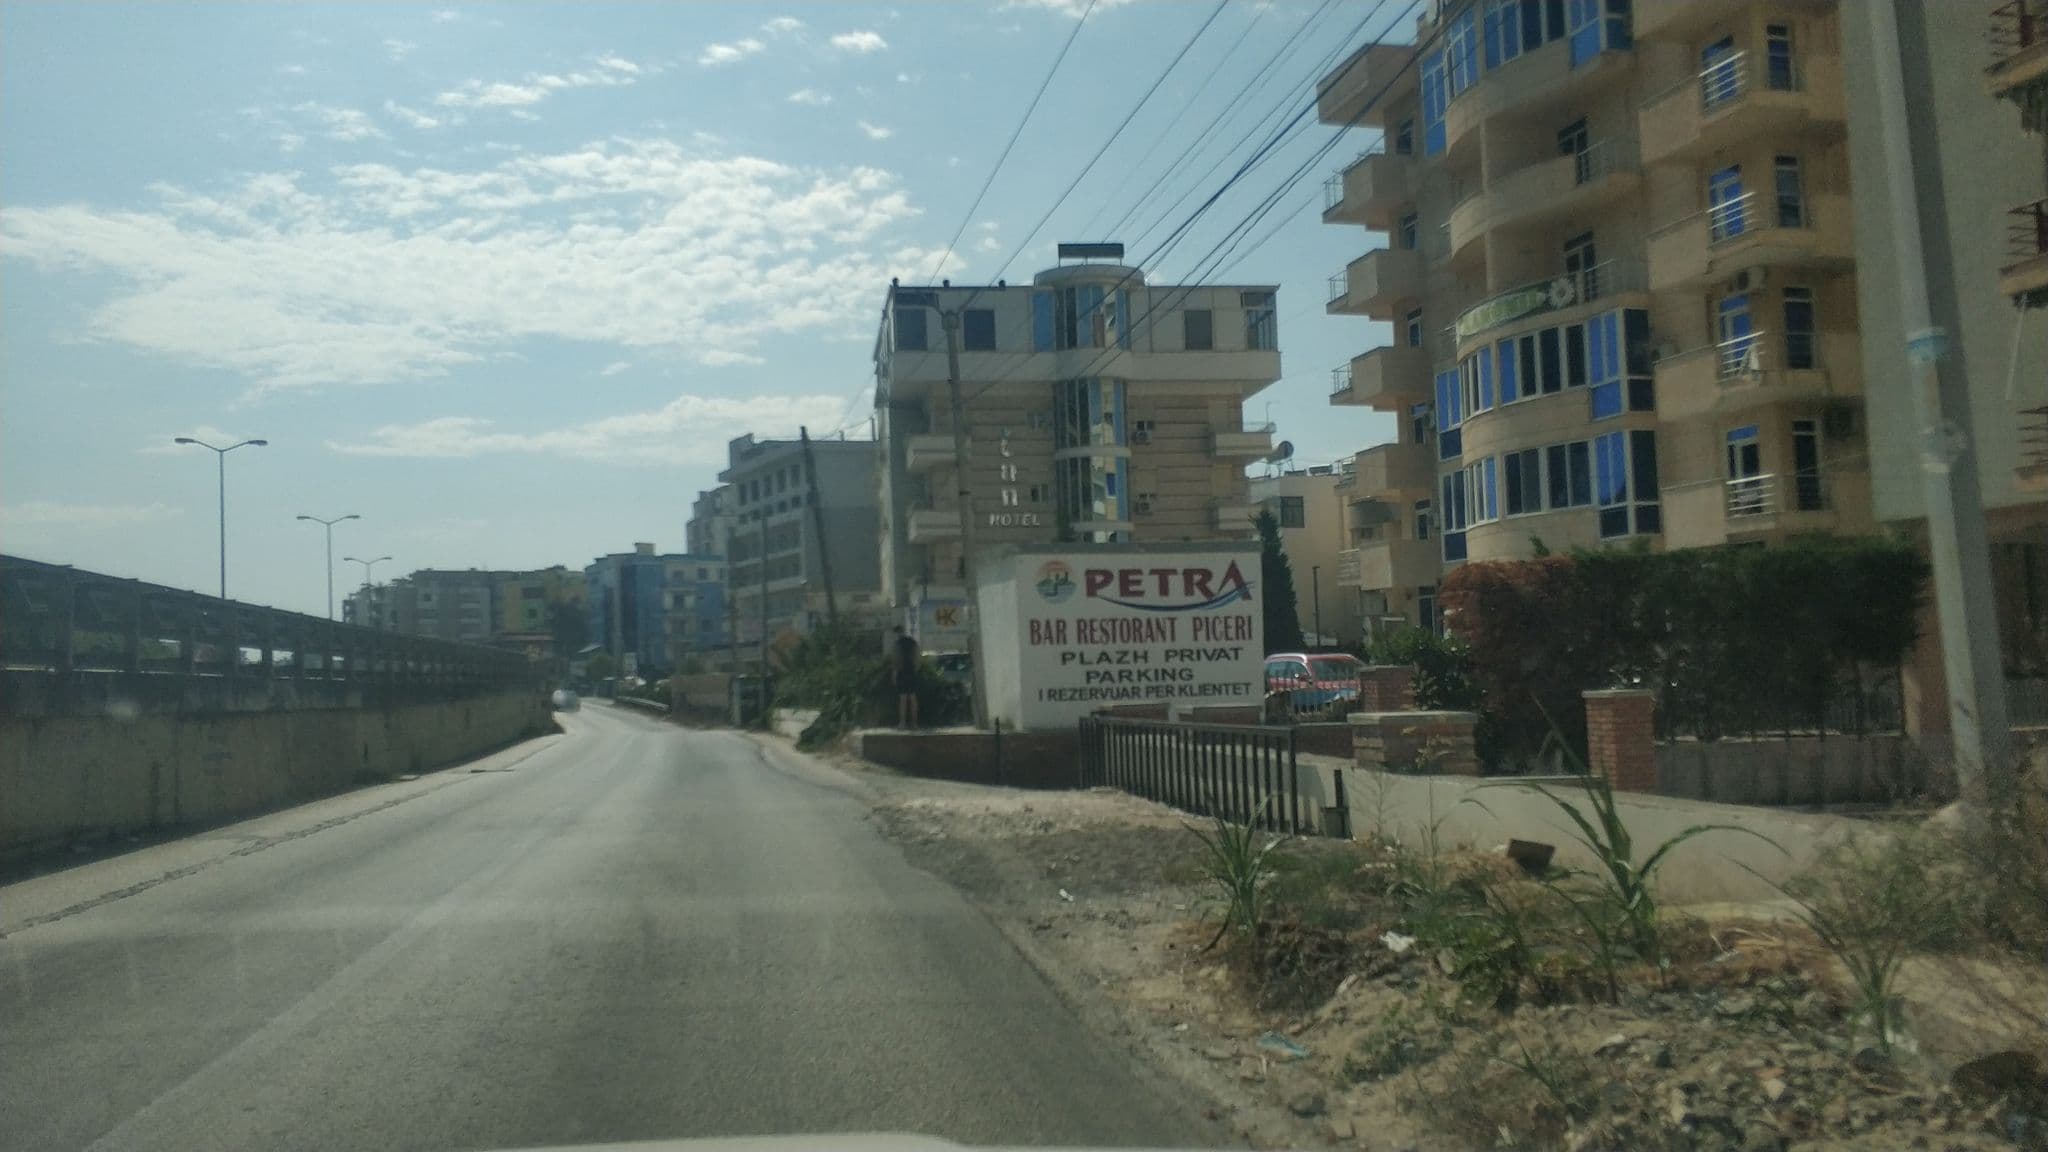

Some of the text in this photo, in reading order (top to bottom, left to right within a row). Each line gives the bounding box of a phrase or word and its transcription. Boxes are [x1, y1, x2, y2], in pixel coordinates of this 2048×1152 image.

[988, 513, 1041, 526] HOTEL
[1084, 559, 1253, 601] PETRA
[1030, 615, 1253, 645] BAR RESTORANT PICERI
[1061, 647, 1244, 665] PLAZH PRIVAT
[1086, 668, 1194, 683] PARKING
[1049, 686, 1141, 701] REZERVUAR
[1145, 685, 1176, 698] PER
[1179, 682, 1253, 697] KLIENTET
